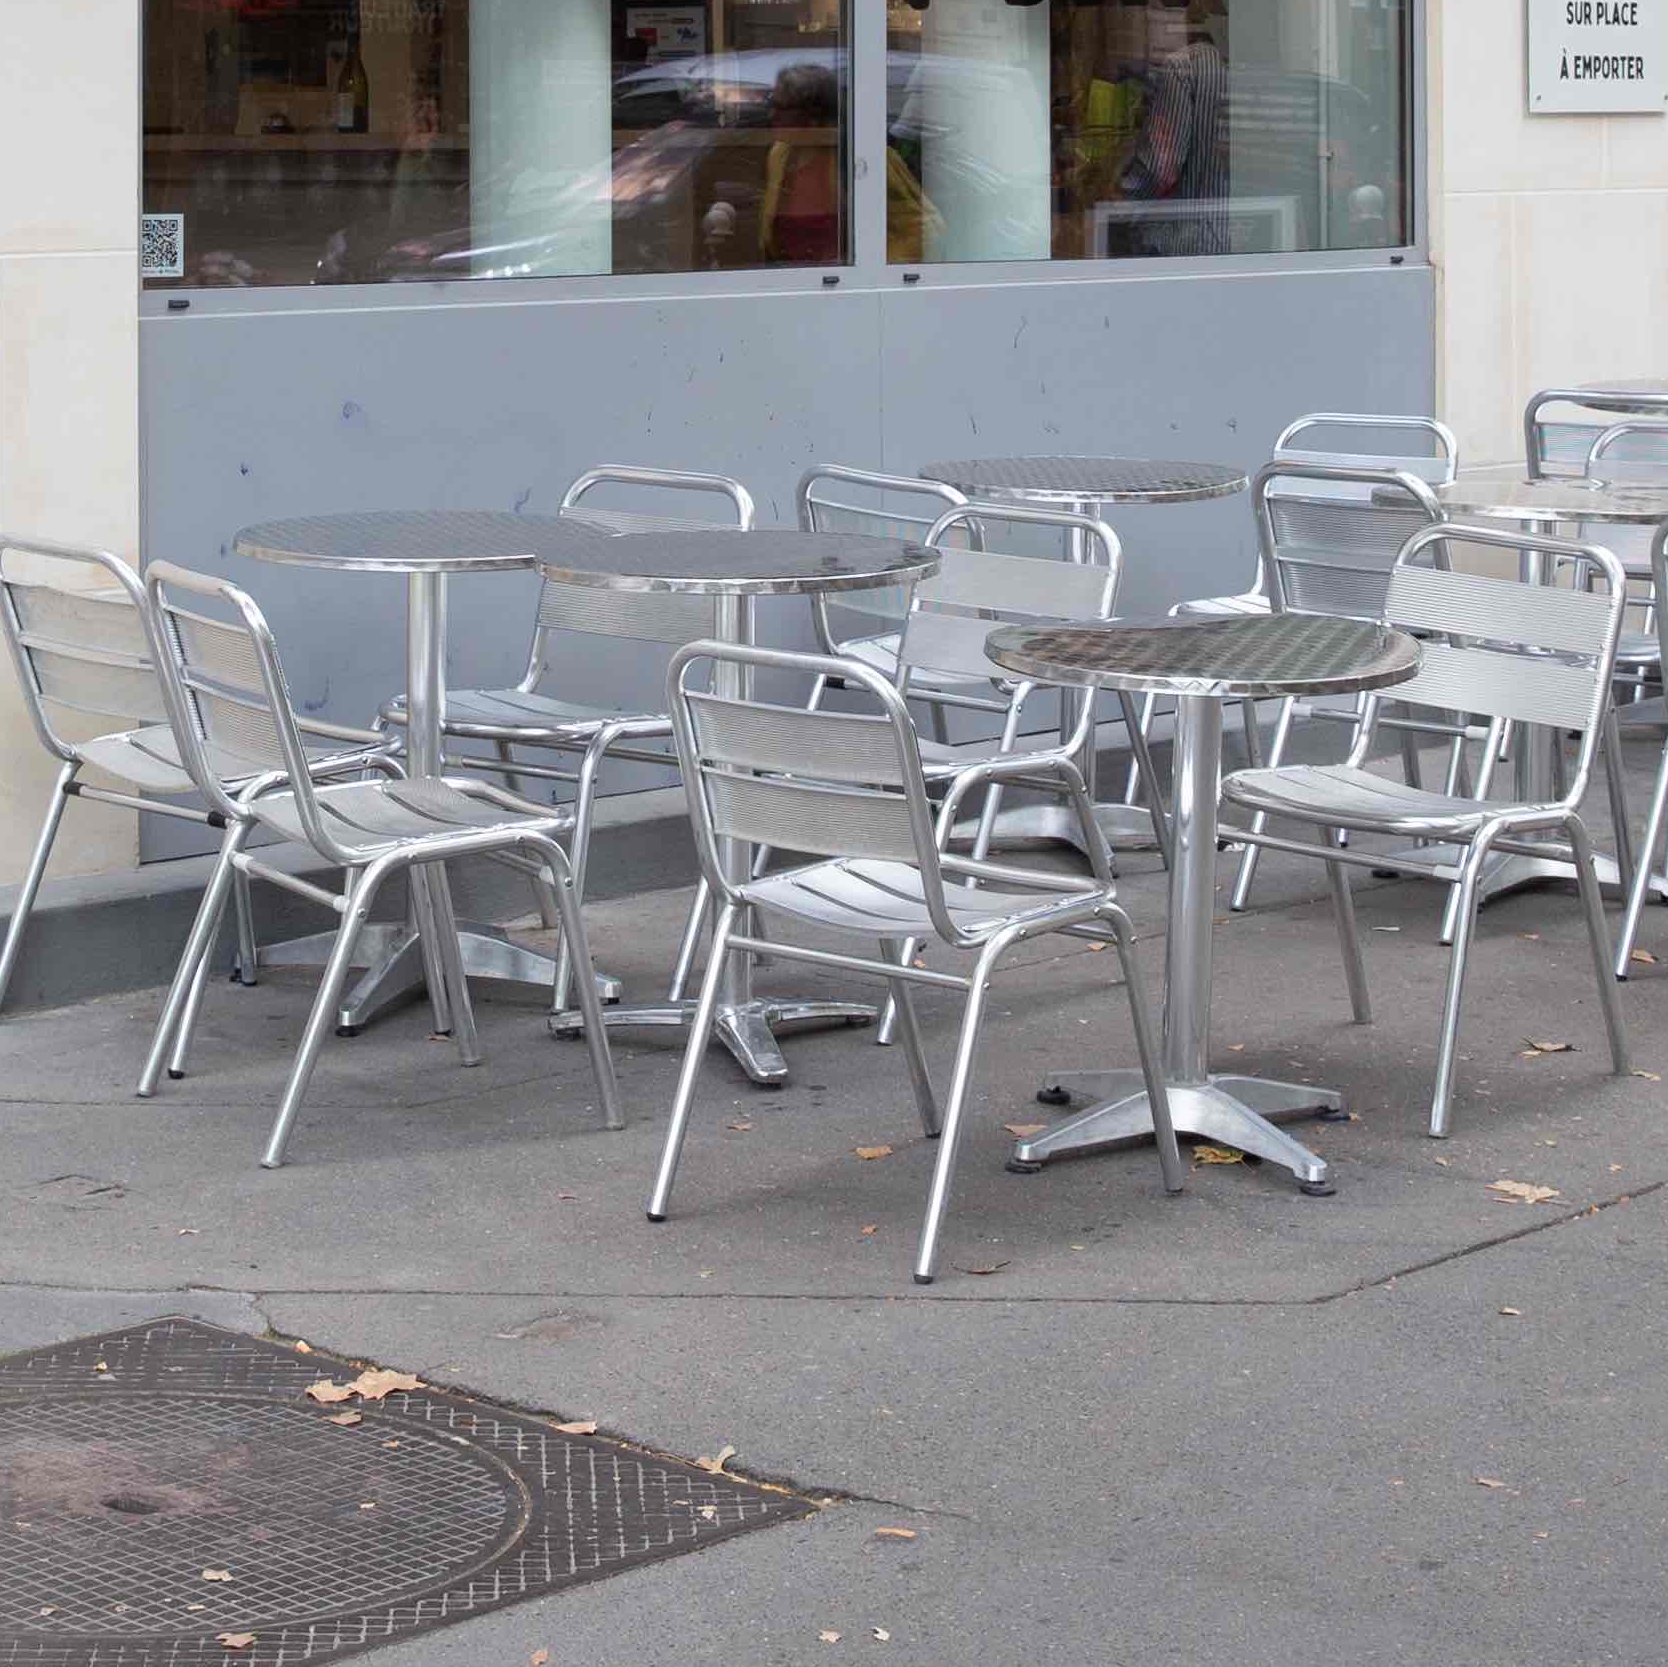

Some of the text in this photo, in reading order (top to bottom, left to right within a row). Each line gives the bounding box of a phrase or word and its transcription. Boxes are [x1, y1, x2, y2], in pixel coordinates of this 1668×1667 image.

[1566, 1, 1638, 26] SUR PLACE
[1559, 48, 1644, 80] À EMPORTER
